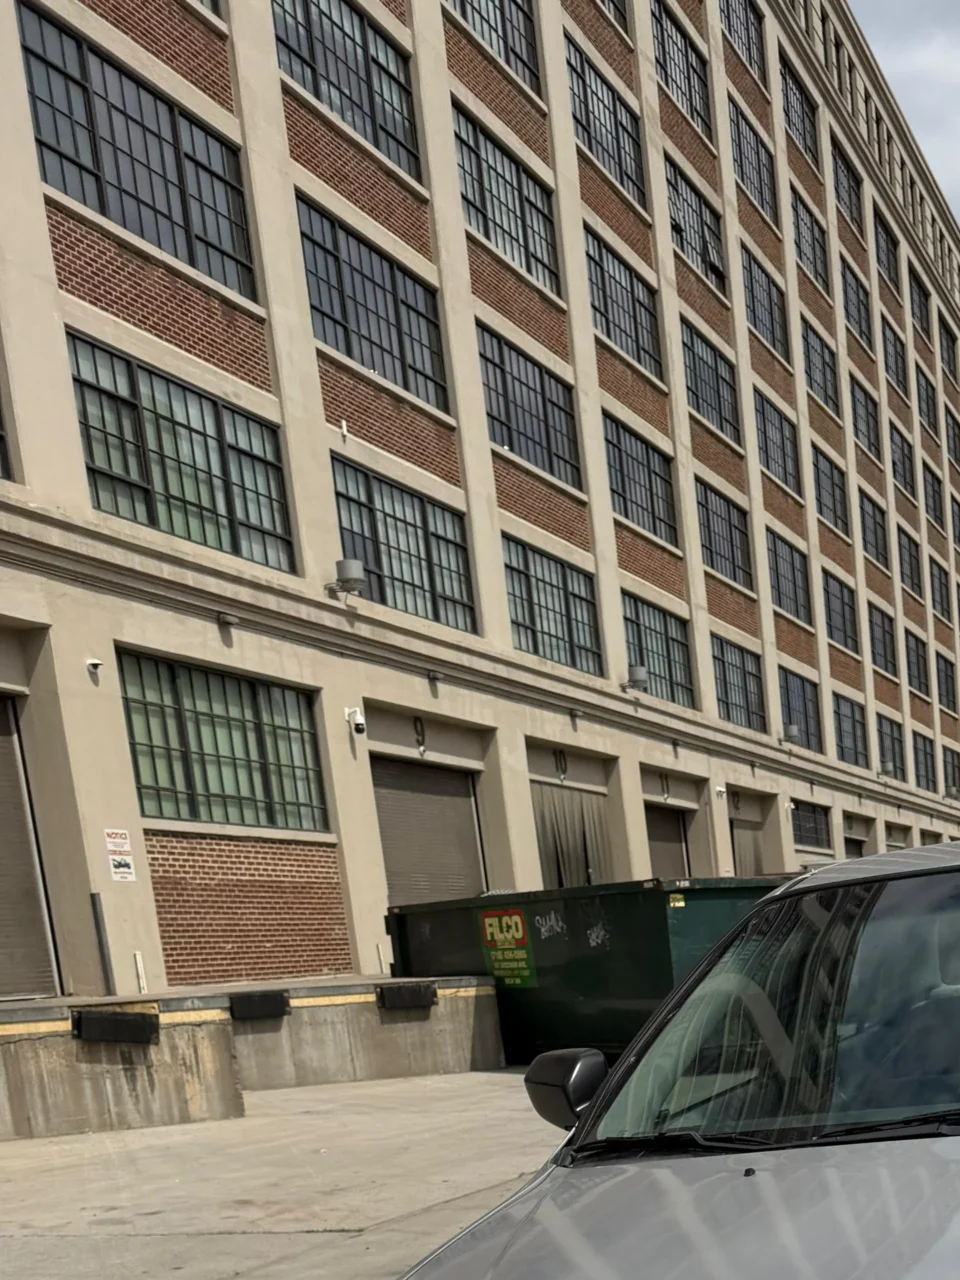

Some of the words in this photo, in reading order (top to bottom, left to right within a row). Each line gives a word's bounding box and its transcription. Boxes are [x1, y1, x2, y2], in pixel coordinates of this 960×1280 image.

[413, 715, 426, 747] 9
[552, 749, 567, 774] 10
[106, 832, 127, 840] NOTICE
[484, 915, 523, 941] FILCO
